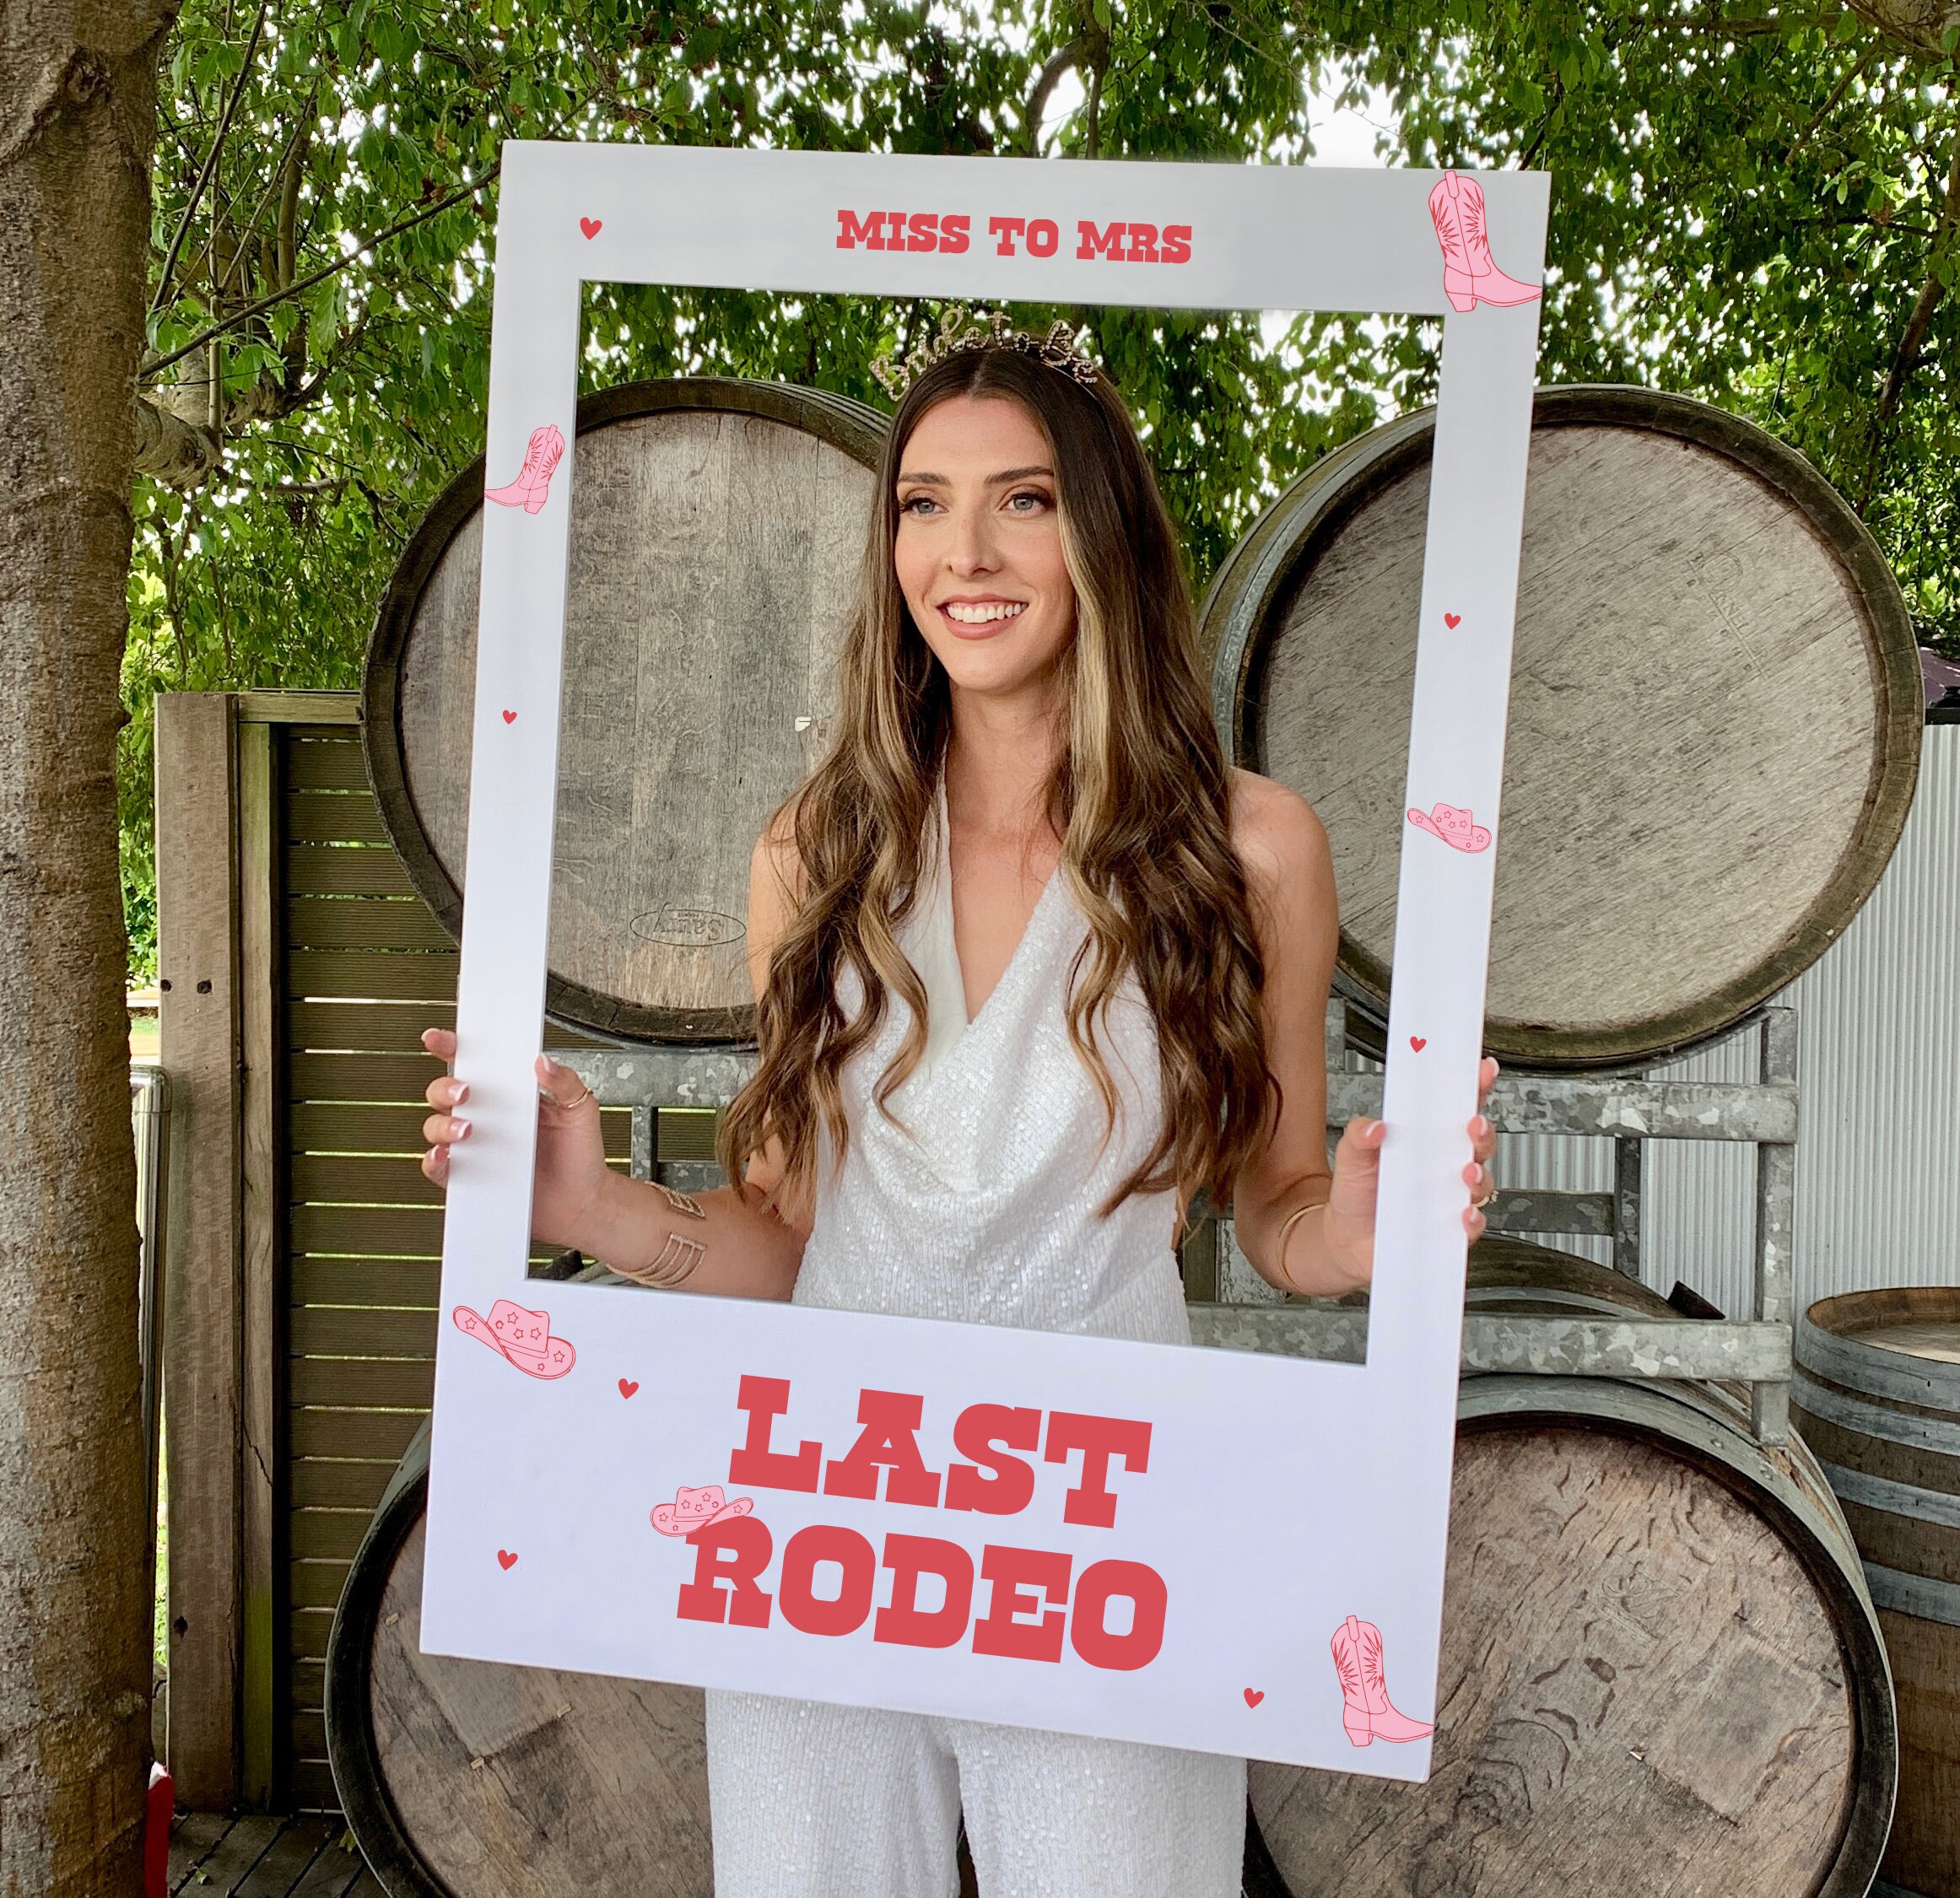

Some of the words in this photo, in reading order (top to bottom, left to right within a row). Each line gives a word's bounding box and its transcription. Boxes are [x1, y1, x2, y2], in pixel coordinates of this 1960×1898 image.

[837, 210, 970, 253] MISS
[989, 217, 1059, 257] TO
[1077, 221, 1192, 263] MRS
[1039, 319, 1098, 383] Be
[729, 1375, 1153, 1529] LAST
[678, 1516, 1168, 1671] RODEO
